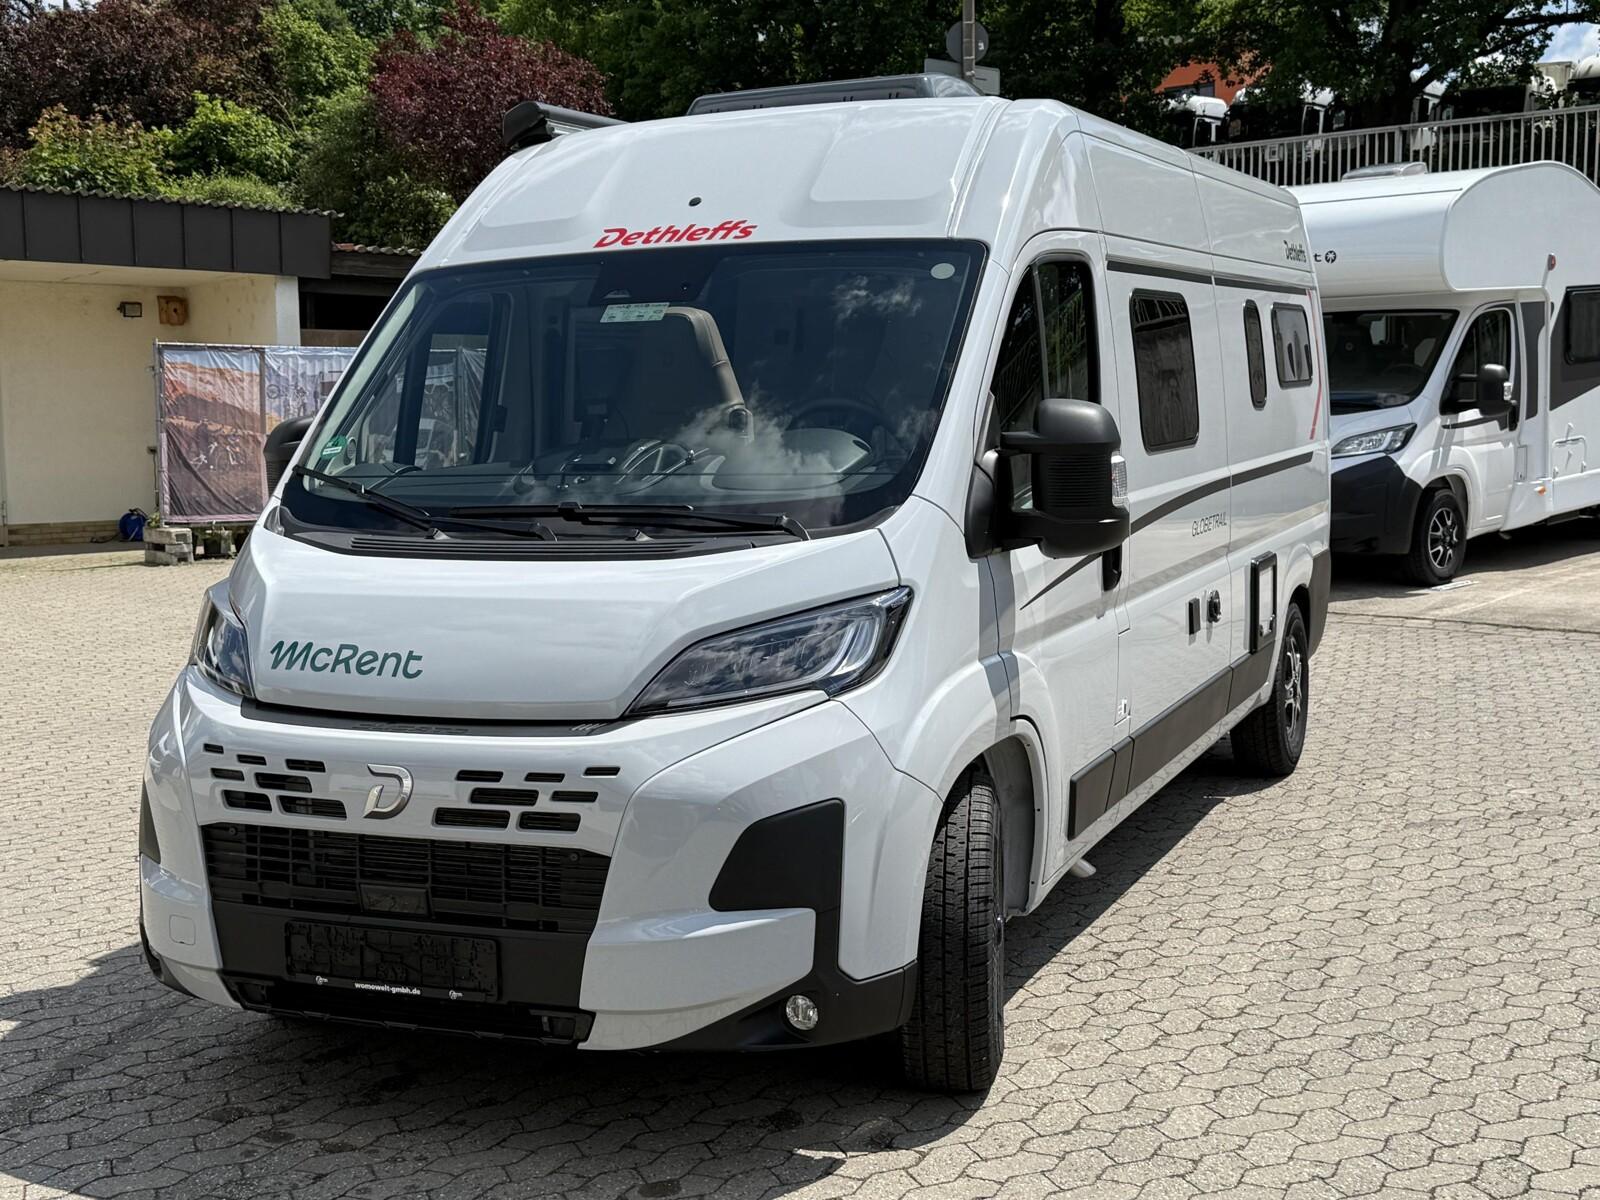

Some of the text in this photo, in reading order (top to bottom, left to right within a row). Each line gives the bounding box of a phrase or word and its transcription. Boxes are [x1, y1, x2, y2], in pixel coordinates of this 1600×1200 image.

[593, 219, 758, 249] Dethleffs
[270, 640, 423, 680] McRent
[354, 982, 421, 995] womowelt-gmbh.de
